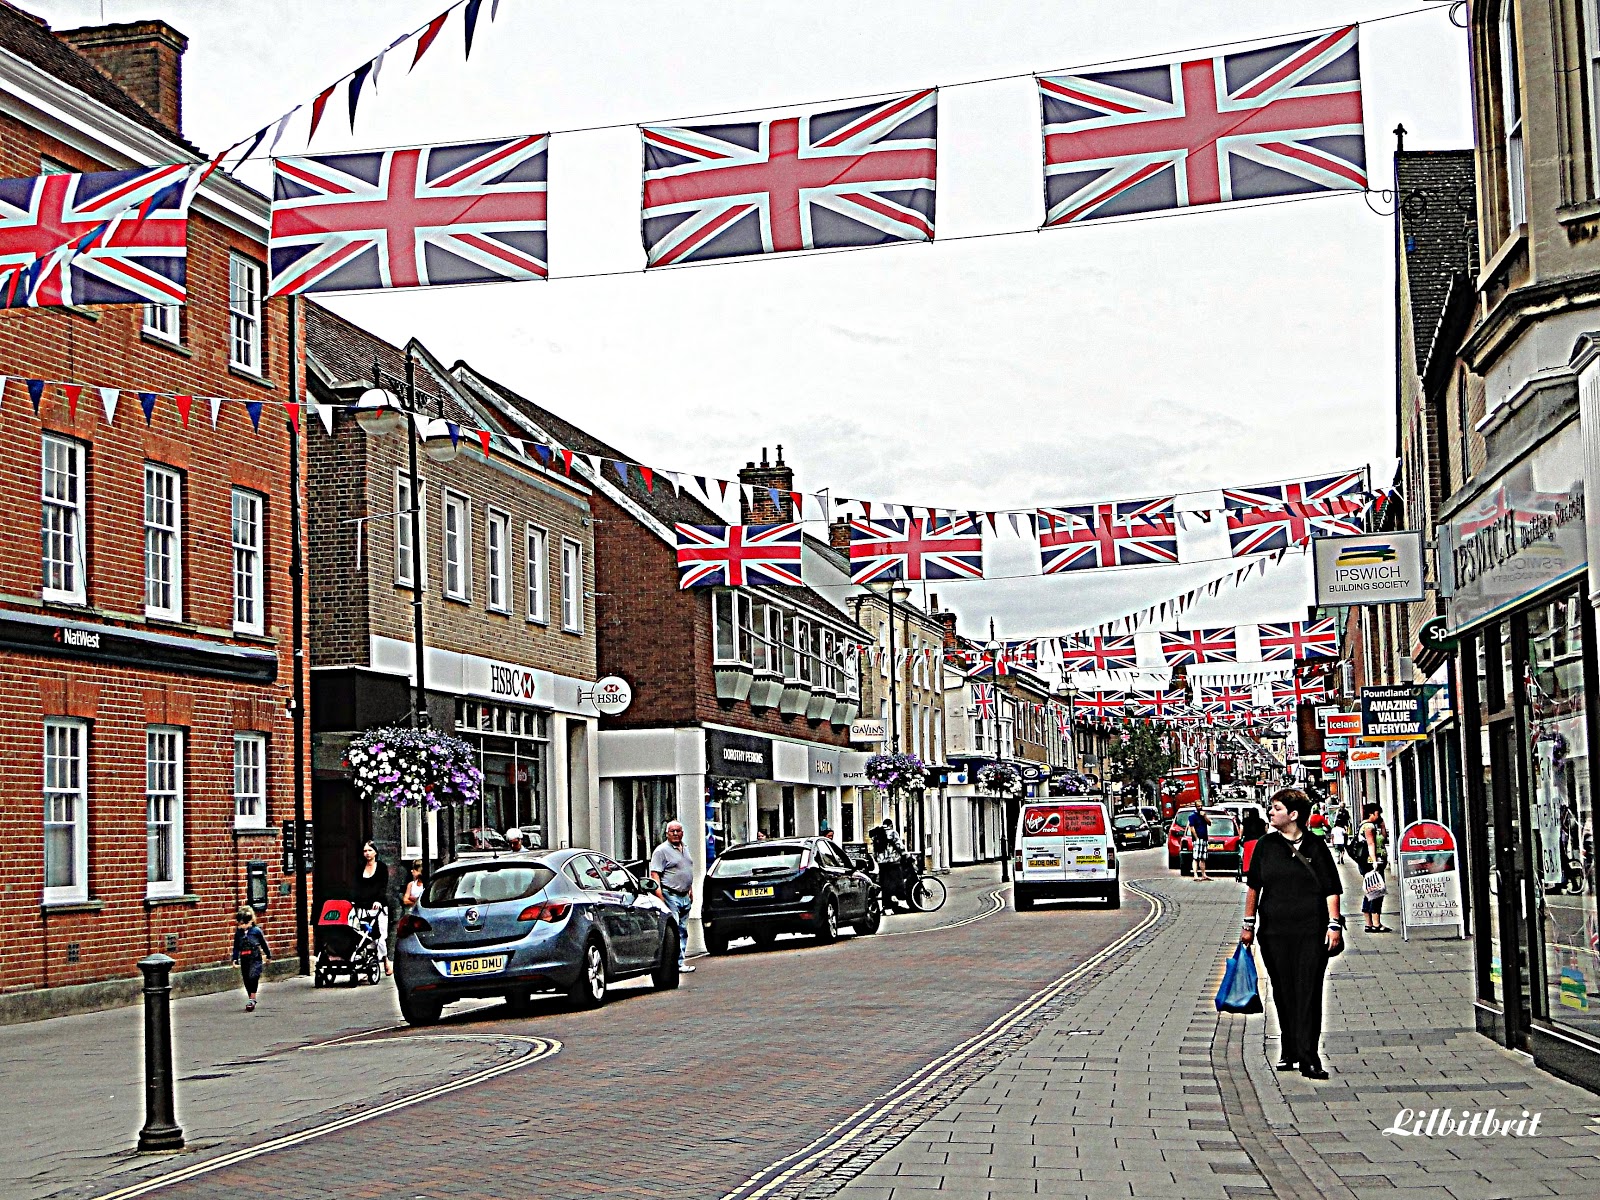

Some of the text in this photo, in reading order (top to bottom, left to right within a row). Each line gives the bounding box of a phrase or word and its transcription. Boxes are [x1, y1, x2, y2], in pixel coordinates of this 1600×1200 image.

[1453, 508, 1517, 590] IPSWICH
[1520, 513, 1556, 549] Building
[1336, 566, 1401, 581] IPSWICH
[1329, 580, 1410, 592] BUILDING SOCIETY
[64, 628, 100, 648] NatWest
[491, 664, 520, 697] HSBC
[597, 693, 627, 703] HSBC
[1363, 689, 1410, 697] Poundland
[1370, 700, 1418, 711] AMAZING
[1377, 711, 1410, 722] VALUE
[852, 724, 885, 734] GAVIN'S
[1368, 722, 1420, 734] EVERYDAY
[723, 748, 763, 763] DOROTHY PERKINS
[1026, 812, 1044, 829] Virgin
[1410, 838, 1443, 846] Hughes
[454, 958, 502, 972] AV60 DMU
